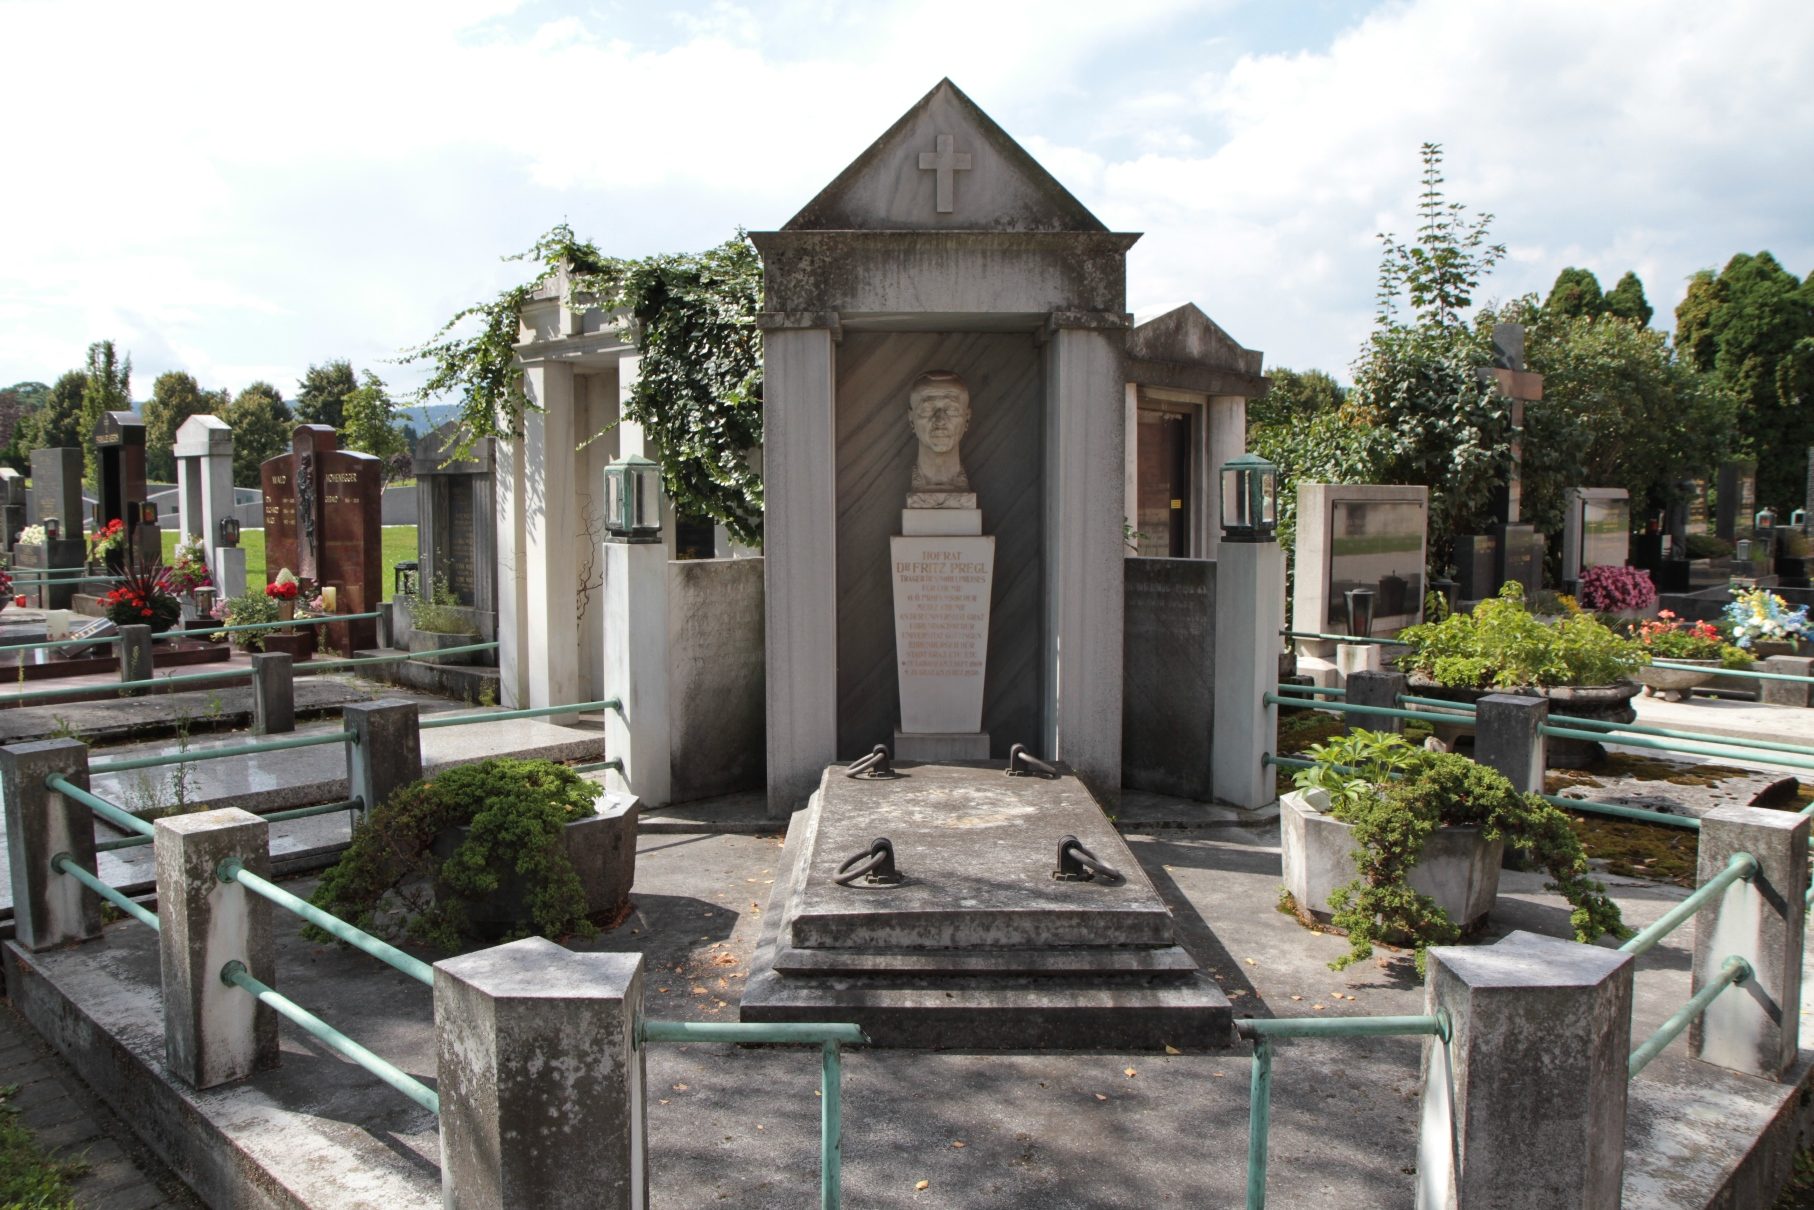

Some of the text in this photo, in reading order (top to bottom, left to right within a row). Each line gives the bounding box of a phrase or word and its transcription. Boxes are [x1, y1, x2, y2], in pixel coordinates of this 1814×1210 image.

[922, 551, 962, 561] HOFRAT
[912, 562, 947, 574] FRITZ
[950, 562, 988, 574] PREGL
